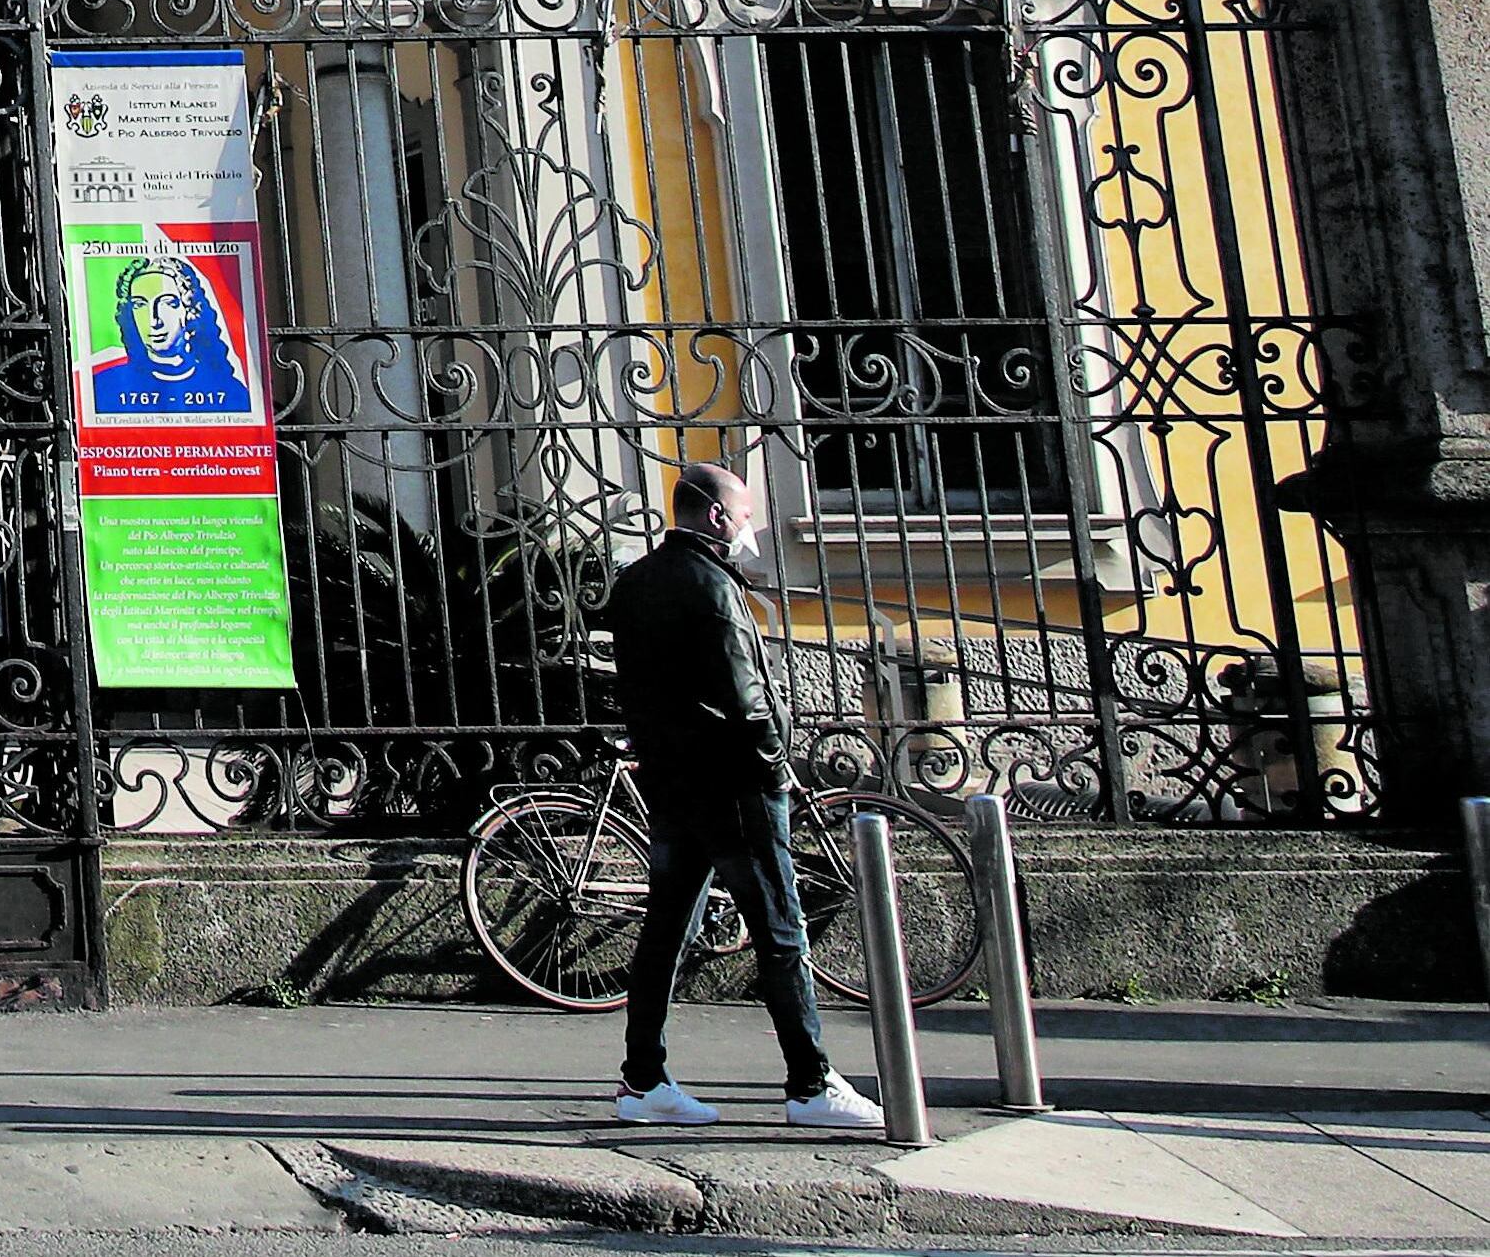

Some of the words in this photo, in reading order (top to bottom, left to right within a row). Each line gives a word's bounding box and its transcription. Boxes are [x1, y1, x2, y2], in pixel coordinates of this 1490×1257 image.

[143, 170, 172, 180] Amici
[175, 170, 192, 180] del
[195, 170, 242, 180] Trivulzio
[143, 181, 173, 190] Onlus
[82, 240, 111, 254] 250
[116, 240, 148, 254] anni
[153, 240, 168, 254] di
[175, 240, 239, 254] Trivulzio
[119, 393, 160, 405] 1767
[184, 392, 226, 404] 2017
[80, 446, 171, 458] ESPOSIZIONE
[175, 446, 272, 458] PERMANENTE
[93, 465, 128, 477] Piano
[131, 466, 160, 476] terra
[171, 465, 226, 476] corridoio
[230, 465, 260, 476] ovest
